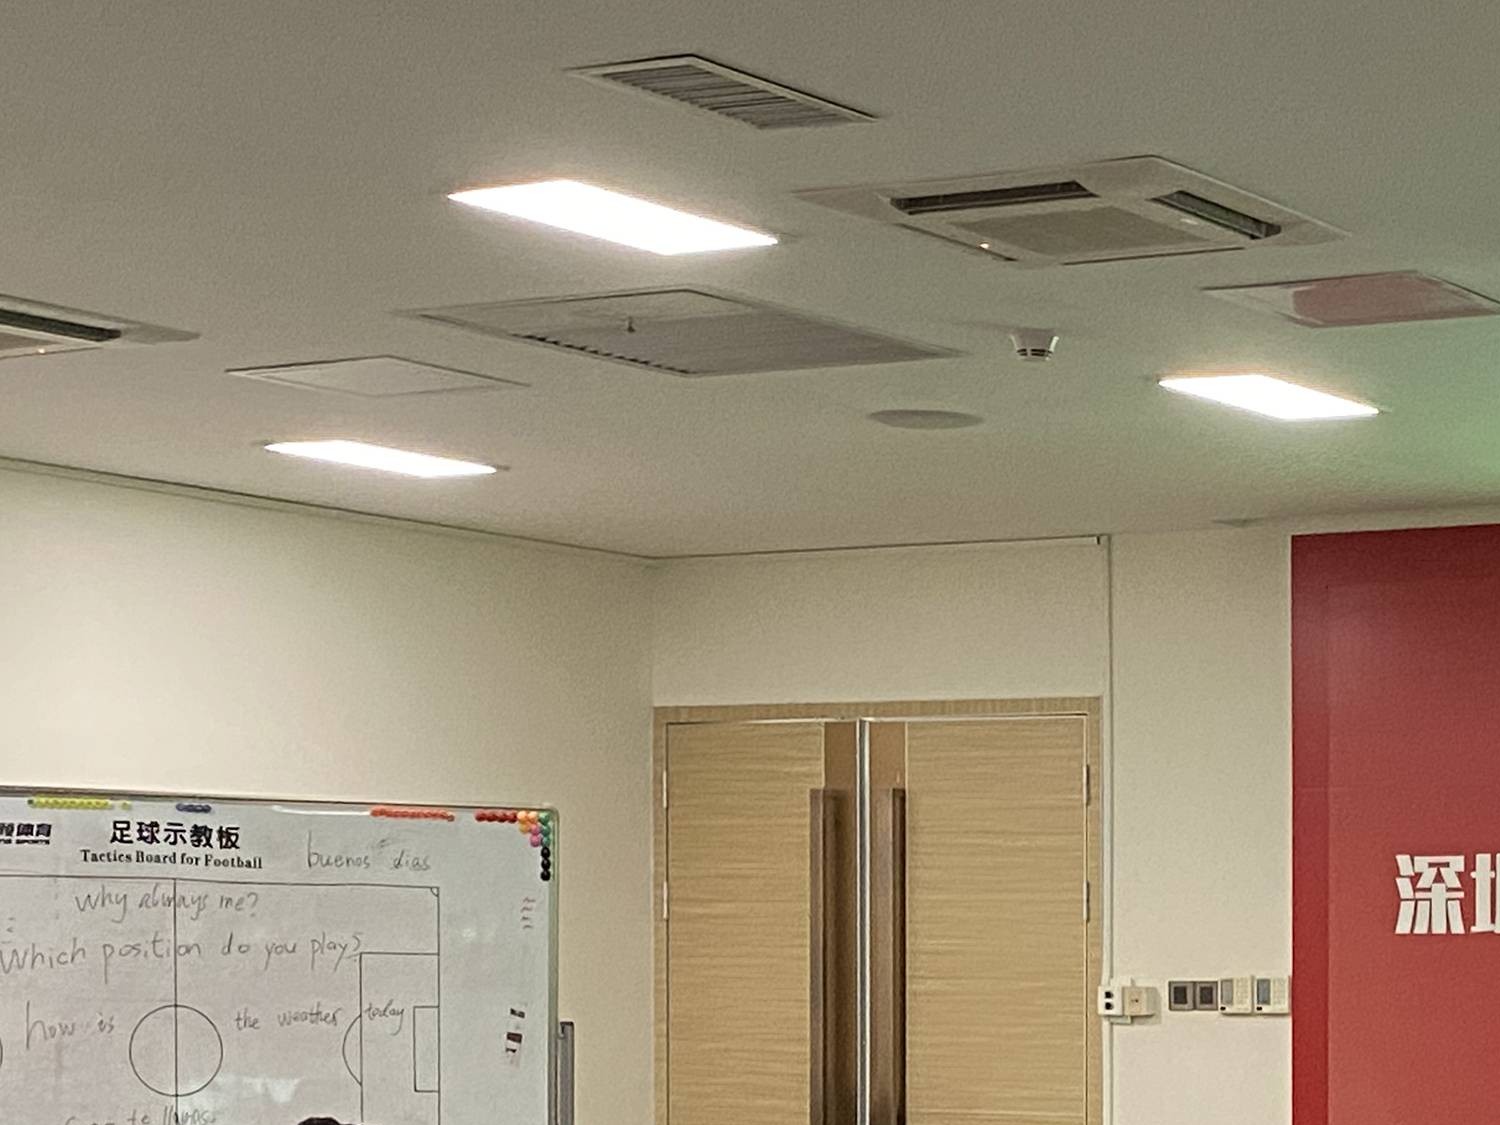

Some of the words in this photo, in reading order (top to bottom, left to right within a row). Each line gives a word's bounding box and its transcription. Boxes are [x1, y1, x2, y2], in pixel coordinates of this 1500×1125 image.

[109, 820, 240, 850] 足球示教板
[307, 830, 371, 870] buenos
[392, 850, 432, 872] dias
[80, 849, 132, 864] Tactics
[135, 851, 177, 865] Board
[180, 852, 200, 867] for
[204, 855, 263, 870] Football
[218, 891, 259, 918] me?
[0, 937, 86, 974] Which
[103, 931, 201, 984] position
[221, 932, 250, 956] do
[265, 942, 297, 971] you
[311, 932, 363, 972] play?
[26, 1000, 75, 1050] how
[97, 1012, 115, 1034] is
[235, 1007, 261, 1031] the
[277, 1001, 342, 1027] weather
[364, 999, 405, 1036] today
